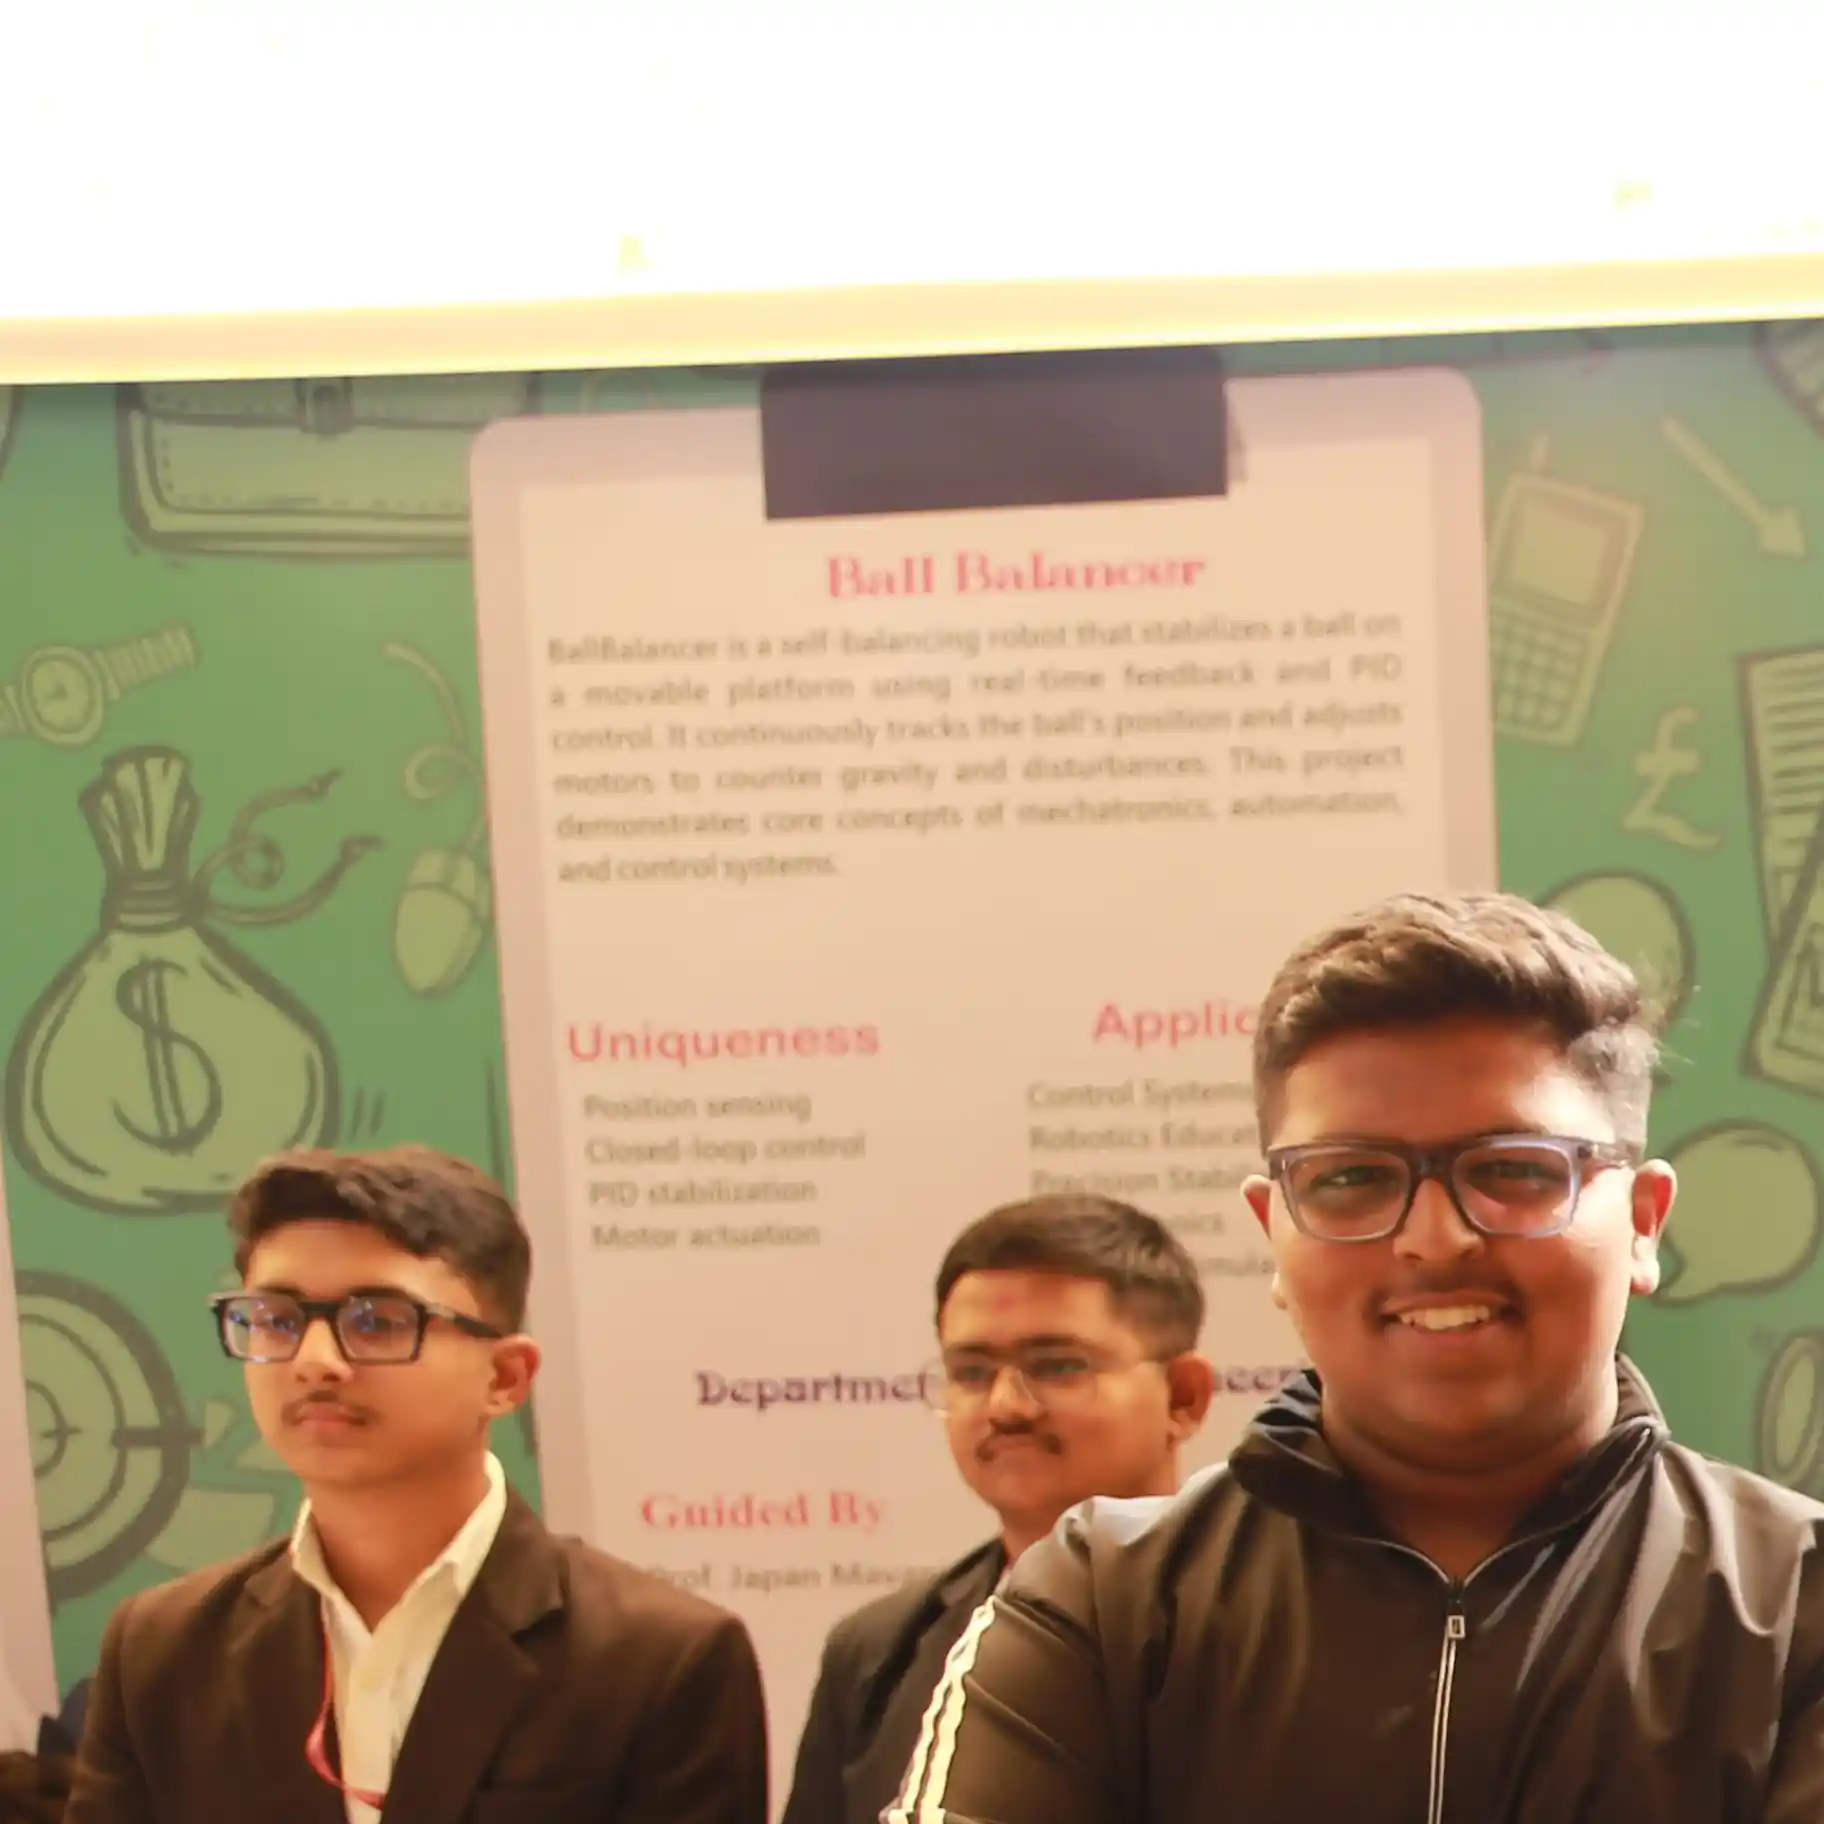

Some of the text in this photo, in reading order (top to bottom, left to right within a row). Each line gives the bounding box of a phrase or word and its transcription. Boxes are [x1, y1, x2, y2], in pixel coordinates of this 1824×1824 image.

[827, 551, 1206, 597] Ball Balancer
[567, 1020, 880, 1068] Uniqueness
[1094, 1000, 1257, 1050] Applic
[640, 1490, 884, 1535] Guided By
